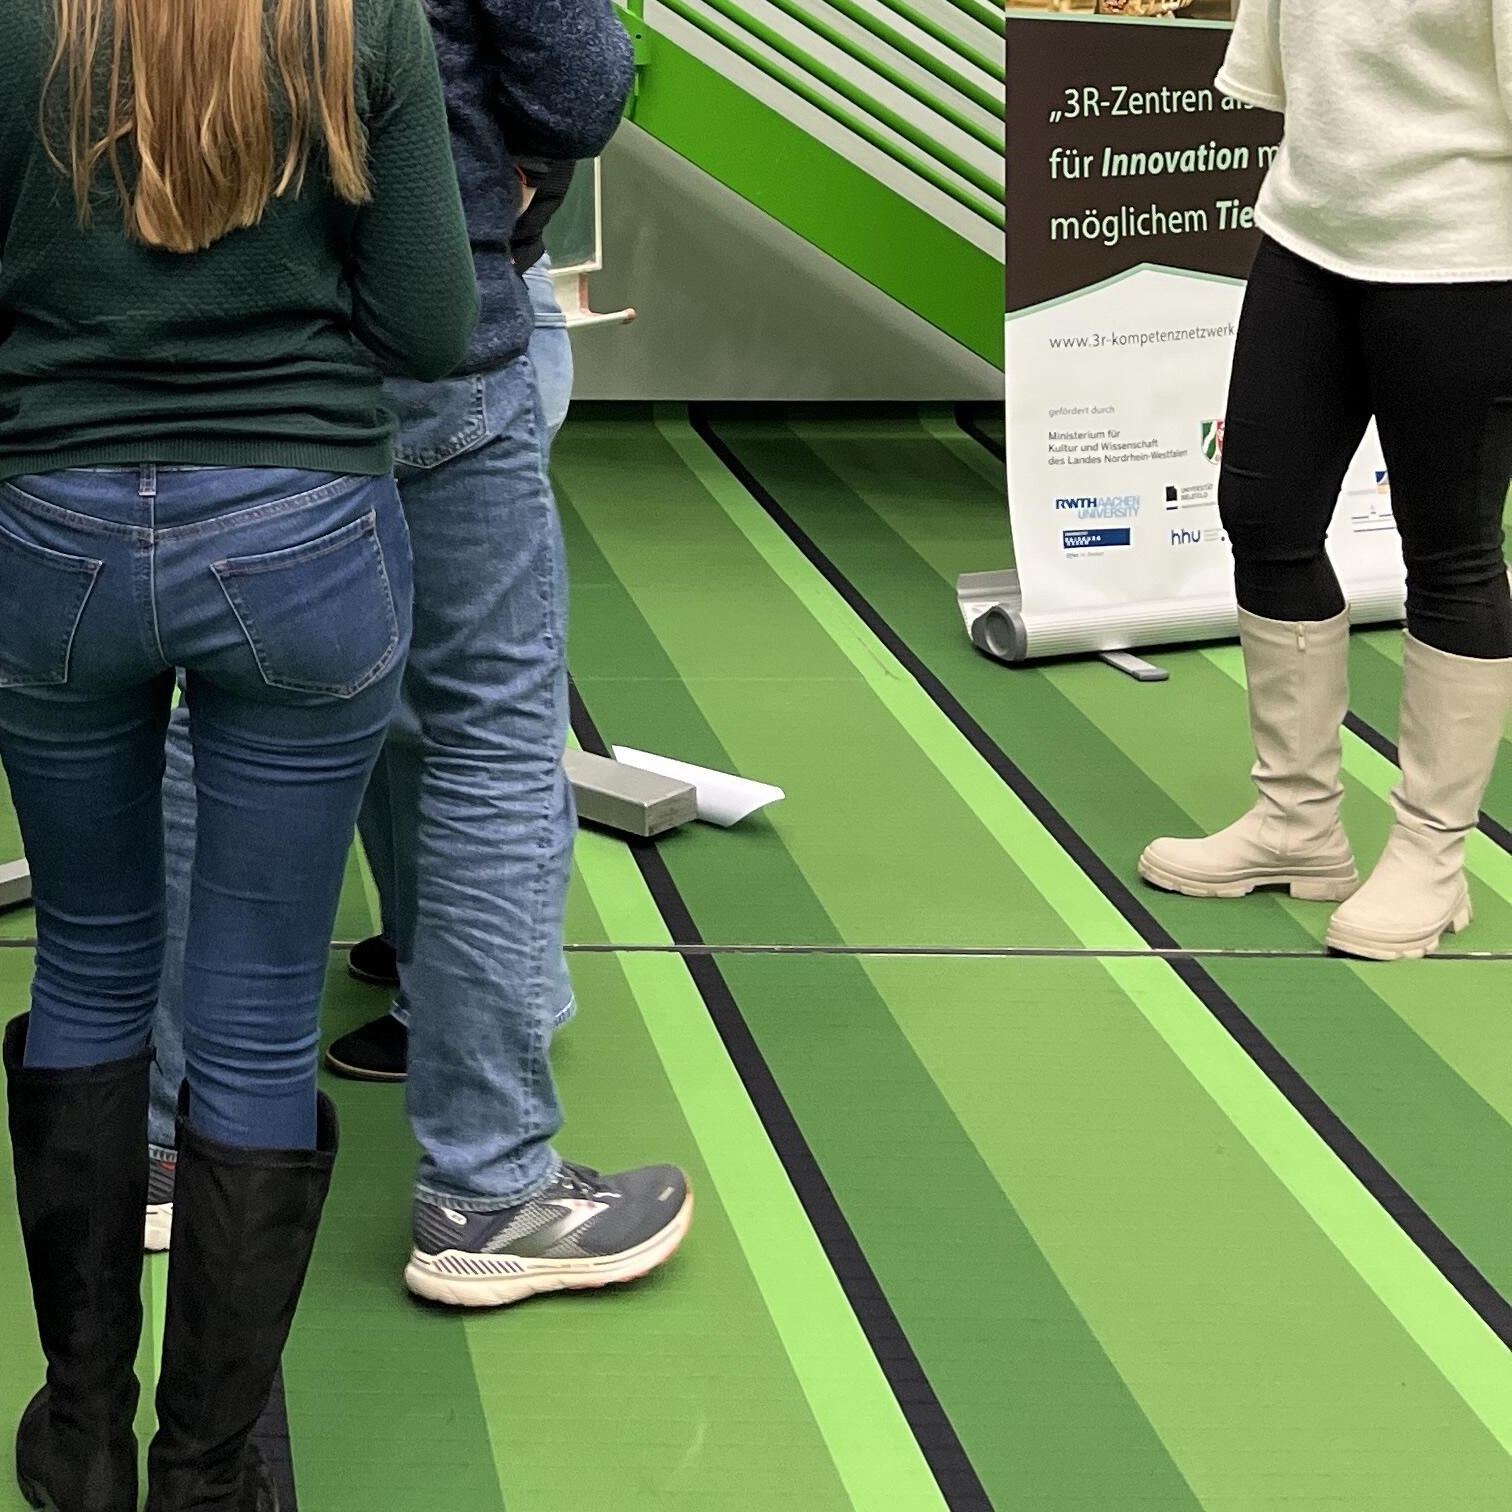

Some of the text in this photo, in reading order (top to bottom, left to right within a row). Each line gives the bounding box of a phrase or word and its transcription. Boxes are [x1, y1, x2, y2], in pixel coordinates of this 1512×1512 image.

[1049, 85, 1213, 123] „3R-Zentren
[1049, 147, 1094, 179] für
[1101, 141, 1250, 177] Innovation
[1050, 199, 1255, 246] möglichem Tie
[1049, 323, 1235, 349] www.3r-kompetenznetzwerk
[1048, 405, 1115, 417] gefördert durch
[1048, 429, 1120, 440] Ministerium für
[1048, 439, 1158, 453] Kultur und Wissenschaft
[1048, 448, 1188, 465] des Landes Nordrhein-Westfalen
[1055, 496, 1140, 510] RWTH AACHEN
[1078, 506, 1141, 520] UNIVERSITY
[1171, 528, 1201, 546] hhu
